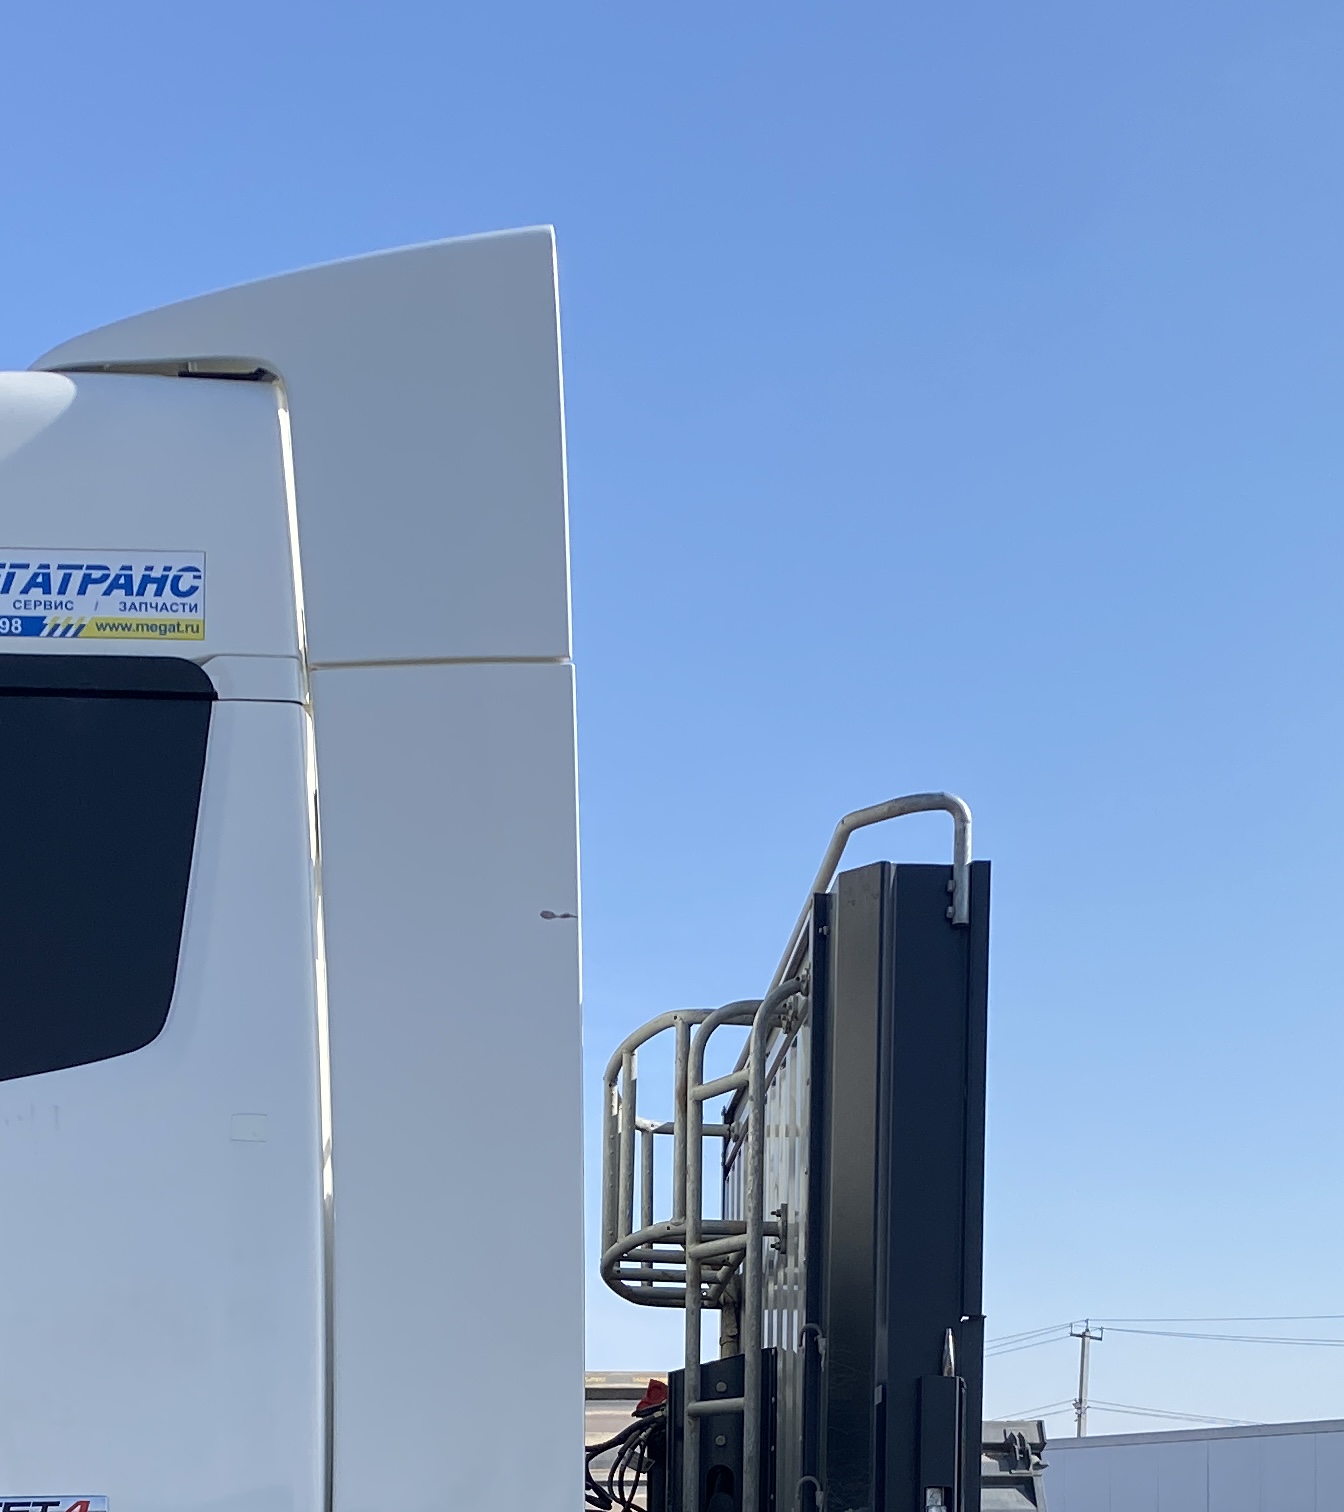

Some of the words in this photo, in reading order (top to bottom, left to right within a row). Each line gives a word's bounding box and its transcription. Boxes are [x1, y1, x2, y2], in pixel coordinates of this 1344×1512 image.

[12, 599, 75, 612] СЕРВИС
[118, 600, 199, 614] ЗАПЧАСТИ
[95, 619, 201, 636] www.megat.ru
